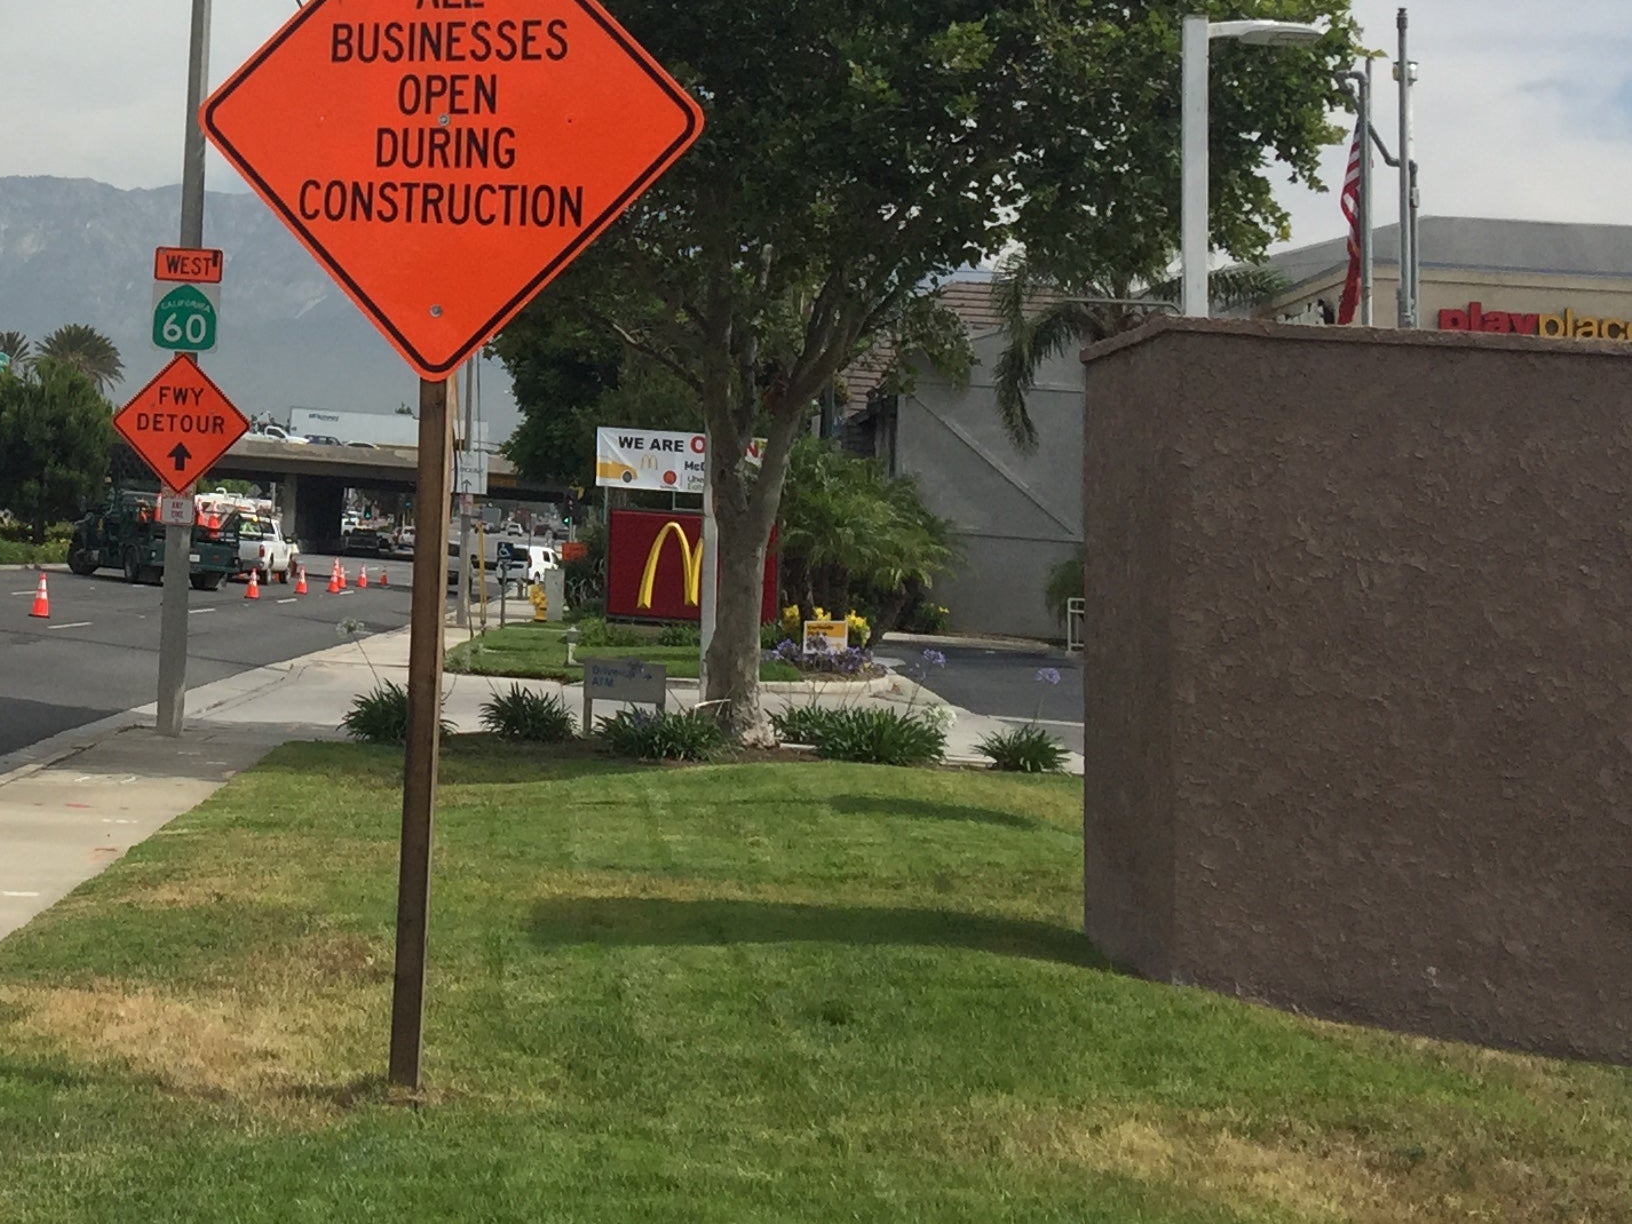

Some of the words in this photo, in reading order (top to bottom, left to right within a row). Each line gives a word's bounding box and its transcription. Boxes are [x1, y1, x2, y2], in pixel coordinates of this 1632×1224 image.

[330, 19, 569, 64] BUSINESSES
[397, 73, 498, 116] OPEN
[375, 126, 517, 170] DURING
[298, 179, 585, 228] CONSTRUCTION
[166, 255, 212, 276] WEST
[160, 298, 211, 313] CALIFORNIA
[1438, 301, 1632, 340] playplac
[162, 312, 207, 344] 60
[158, 386, 205, 407] FWY
[136, 412, 225, 434] DETOUR
[618, 436, 644, 450] WE
[649, 438, 685, 453] ARE
